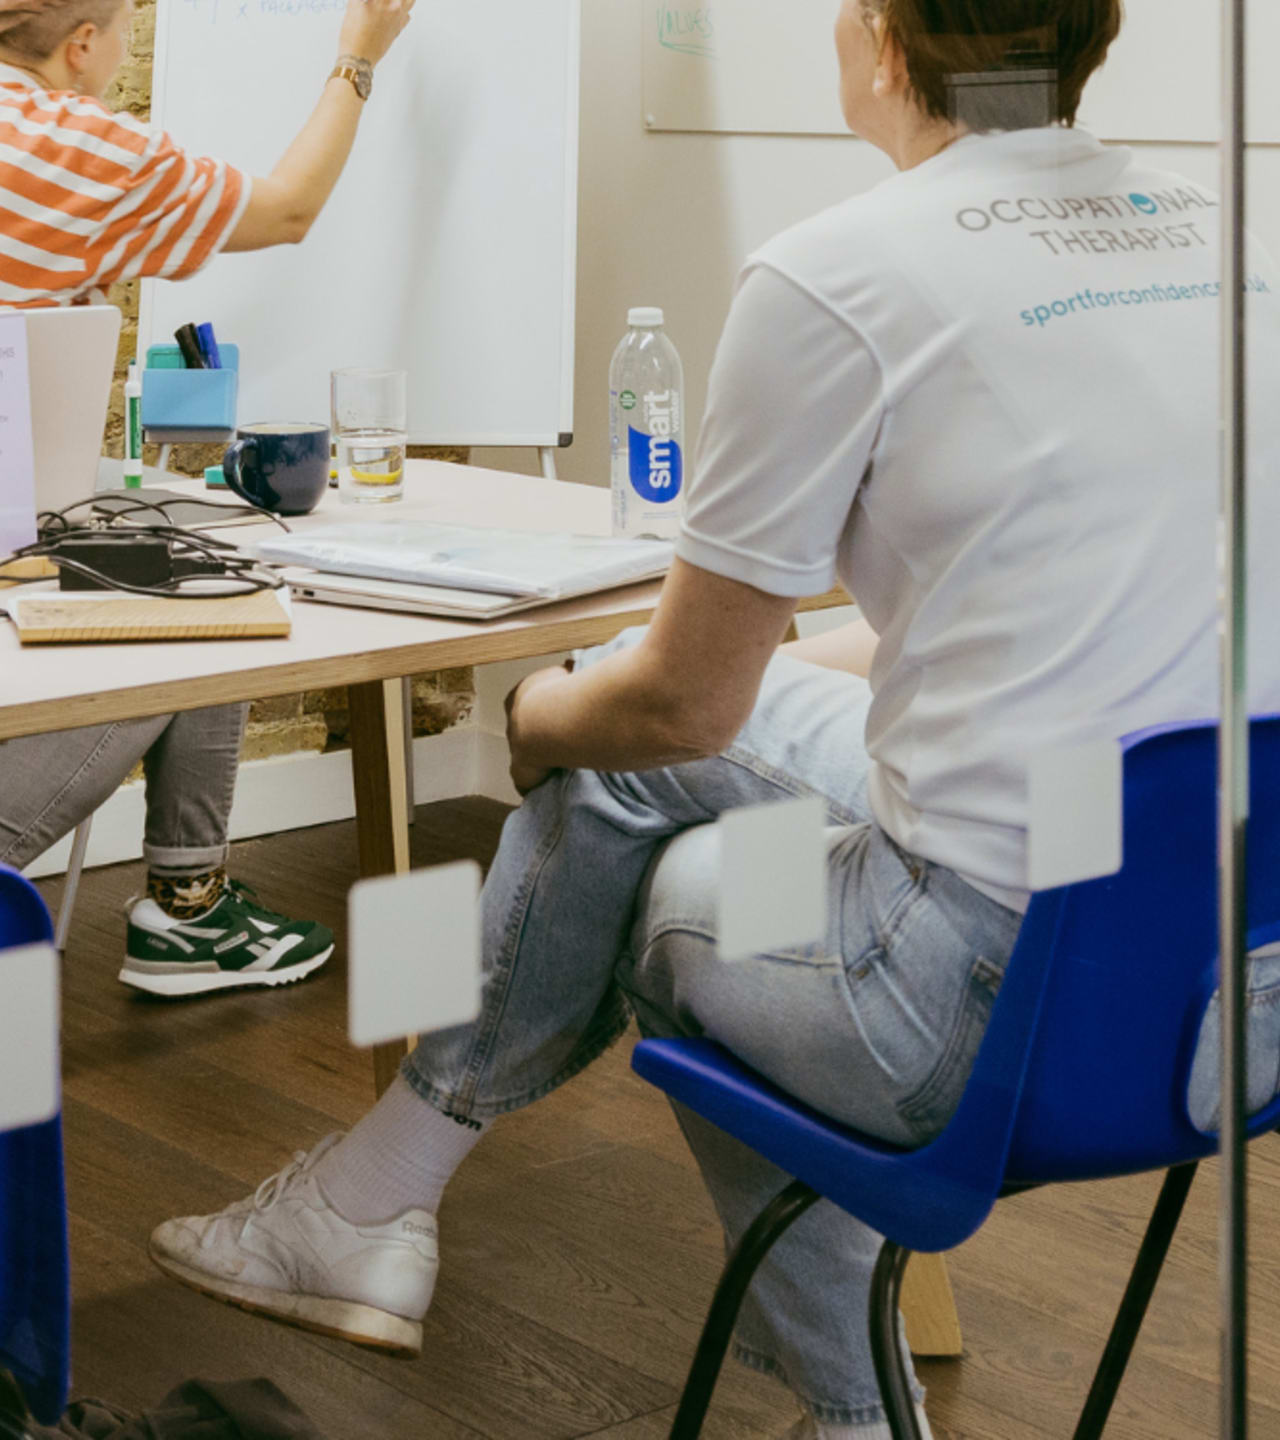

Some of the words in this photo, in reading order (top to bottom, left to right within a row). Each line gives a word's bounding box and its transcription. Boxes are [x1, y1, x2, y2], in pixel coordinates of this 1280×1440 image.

[956, 186, 1219, 232] OCCUPATIONAL
[1029, 222, 1208, 255] THERAPIST
[643, 390, 671, 489] smart
